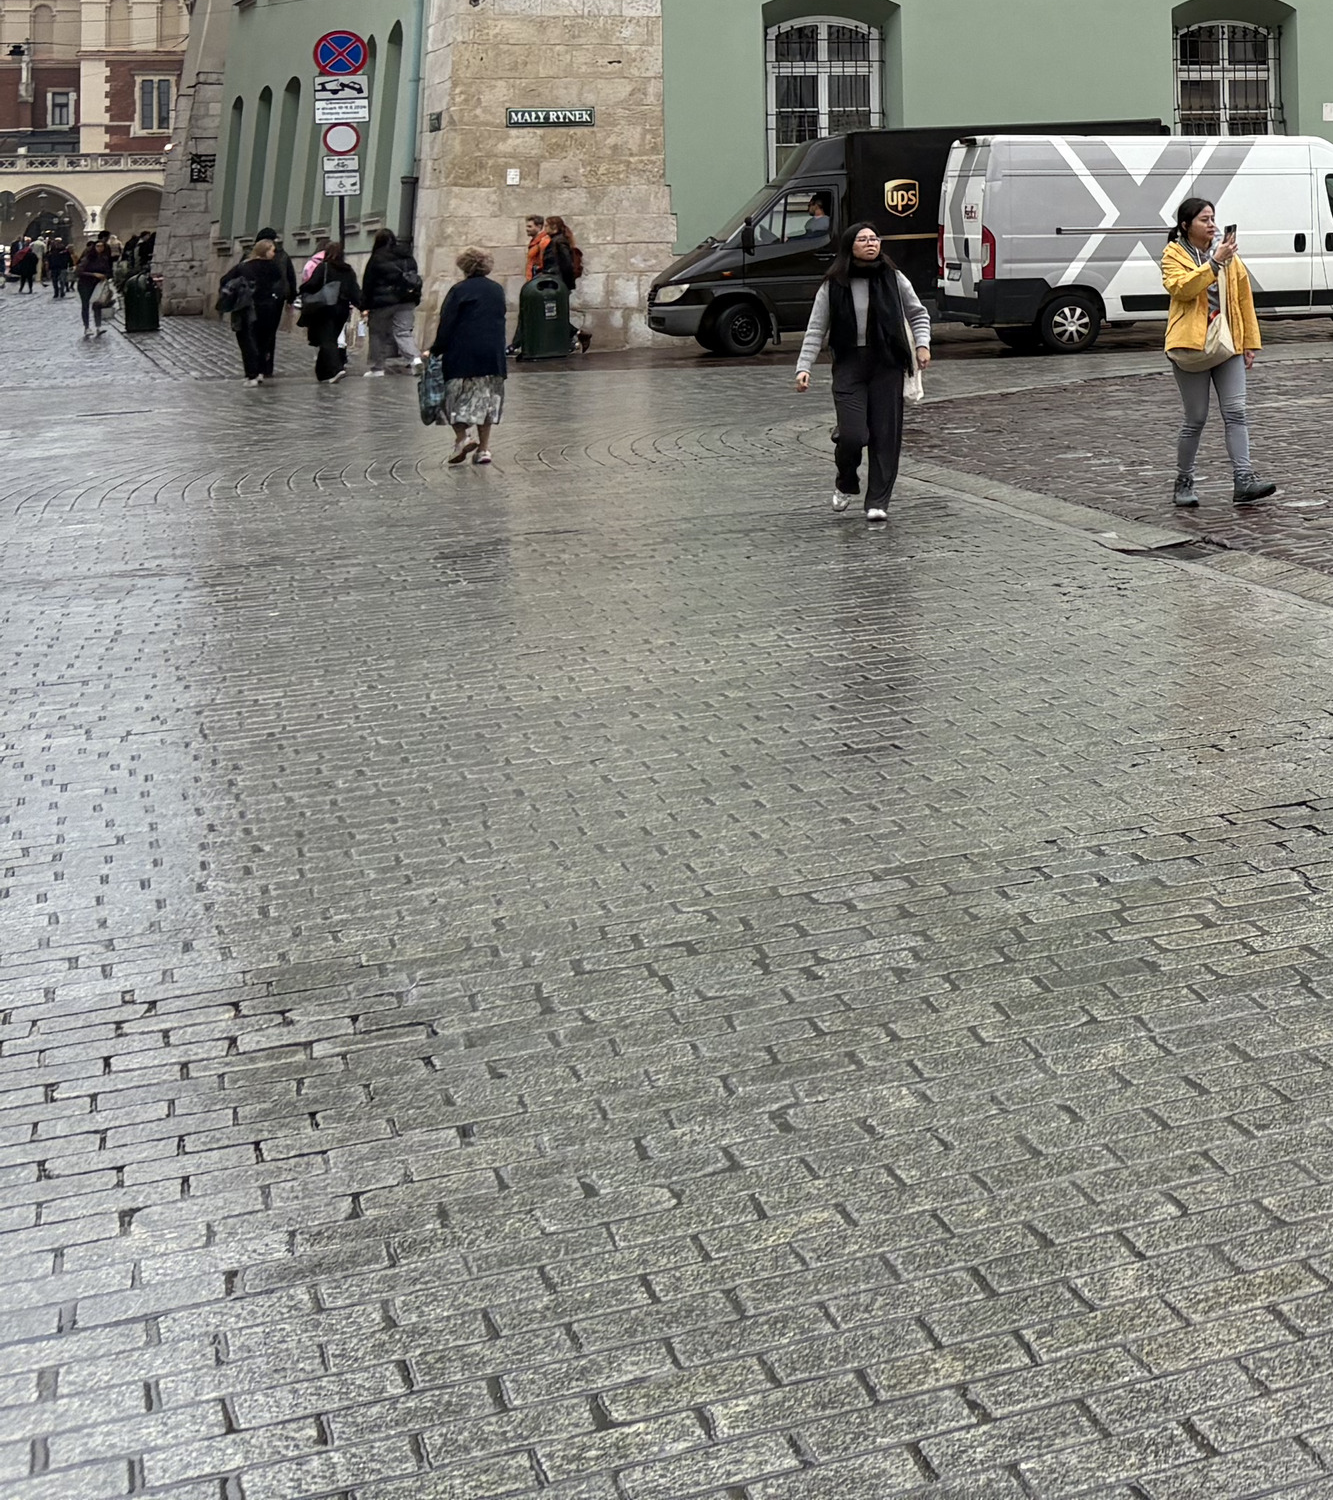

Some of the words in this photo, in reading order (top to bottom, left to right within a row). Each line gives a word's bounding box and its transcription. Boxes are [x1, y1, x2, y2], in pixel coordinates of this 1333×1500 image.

[510, 111, 547, 123] MAŁY
[549, 110, 592, 122] RYNEK
[887, 190, 917, 211] ups
